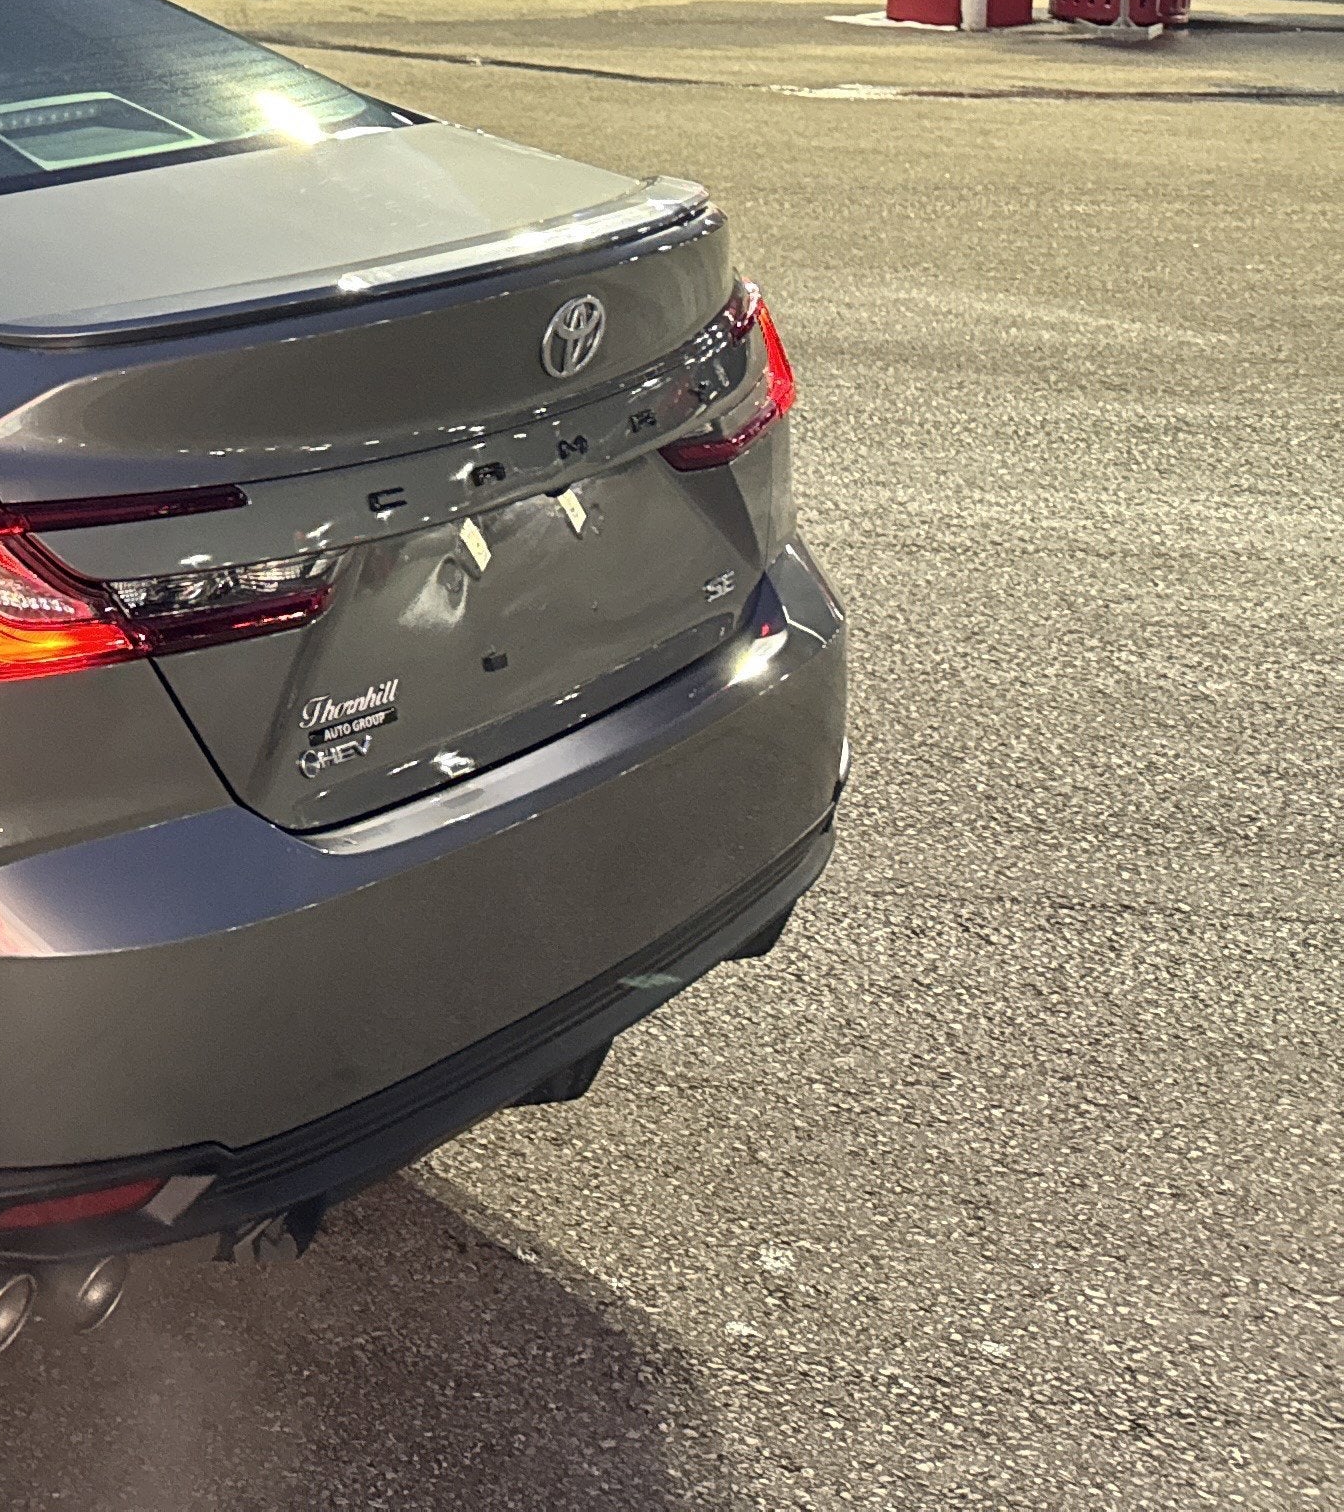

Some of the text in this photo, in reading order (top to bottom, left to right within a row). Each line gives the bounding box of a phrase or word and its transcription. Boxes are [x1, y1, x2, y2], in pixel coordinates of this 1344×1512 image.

[703, 569, 736, 603] SE
[298, 678, 399, 729] Thornhill
[324, 711, 386, 742] AUTO GROUP
